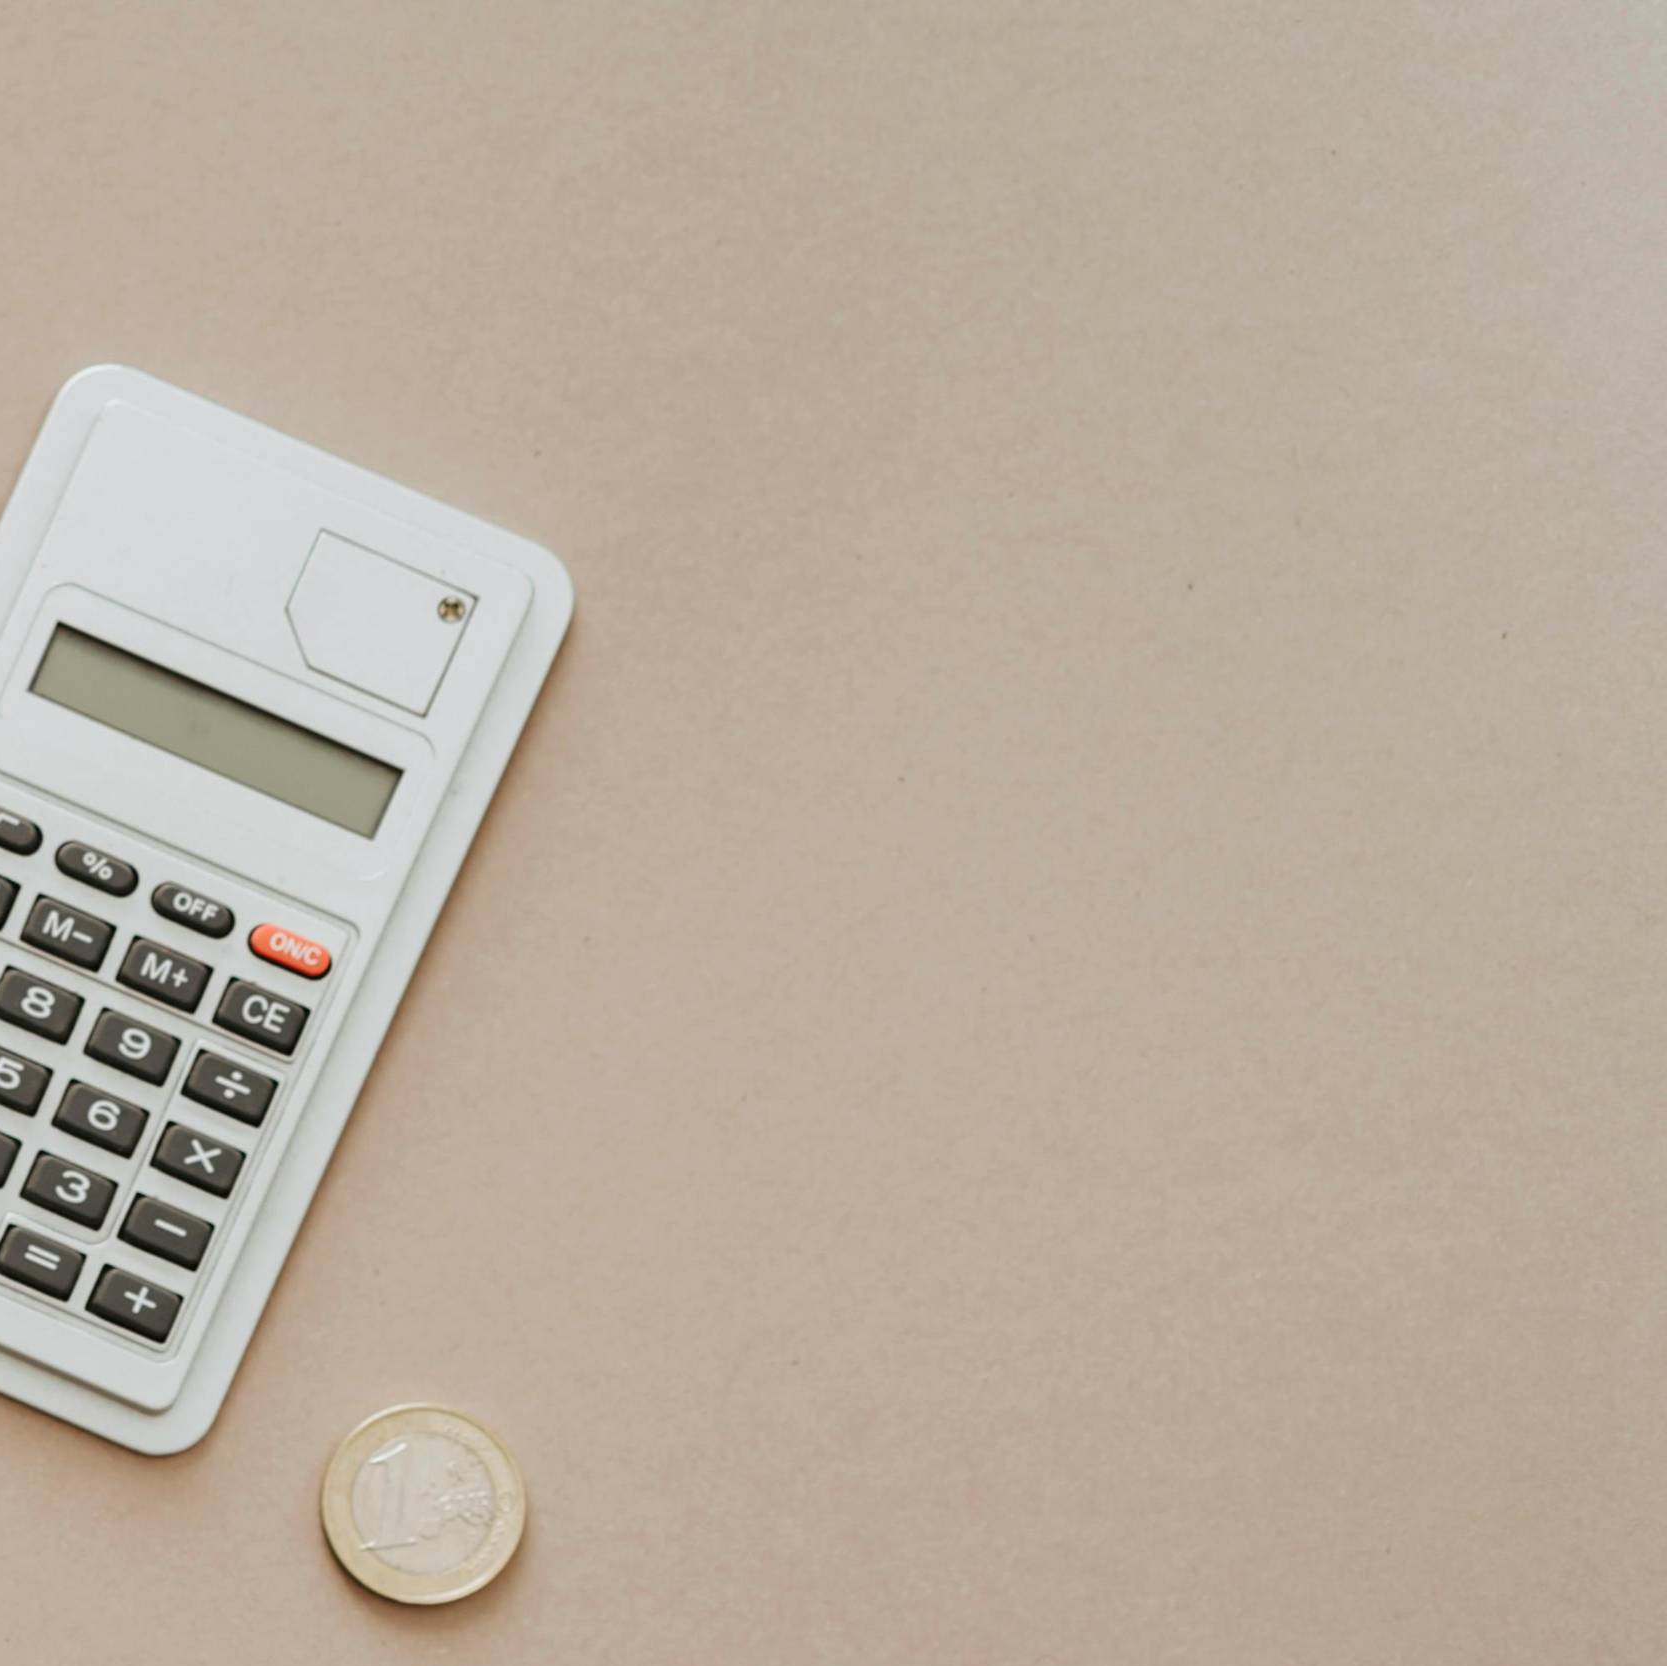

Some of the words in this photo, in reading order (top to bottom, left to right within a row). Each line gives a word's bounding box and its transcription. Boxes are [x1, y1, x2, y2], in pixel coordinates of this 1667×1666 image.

[172, 891, 219, 922] OFF
[269, 931, 323, 966] ON/C
[140, 952, 189, 989] M+
[19, 986, 56, 1019] 8
[241, 994, 291, 1034] CE
[117, 1027, 152, 1059] 9
[86, 1100, 122, 1132] 6
[54, 1170, 92, 1204] 3
